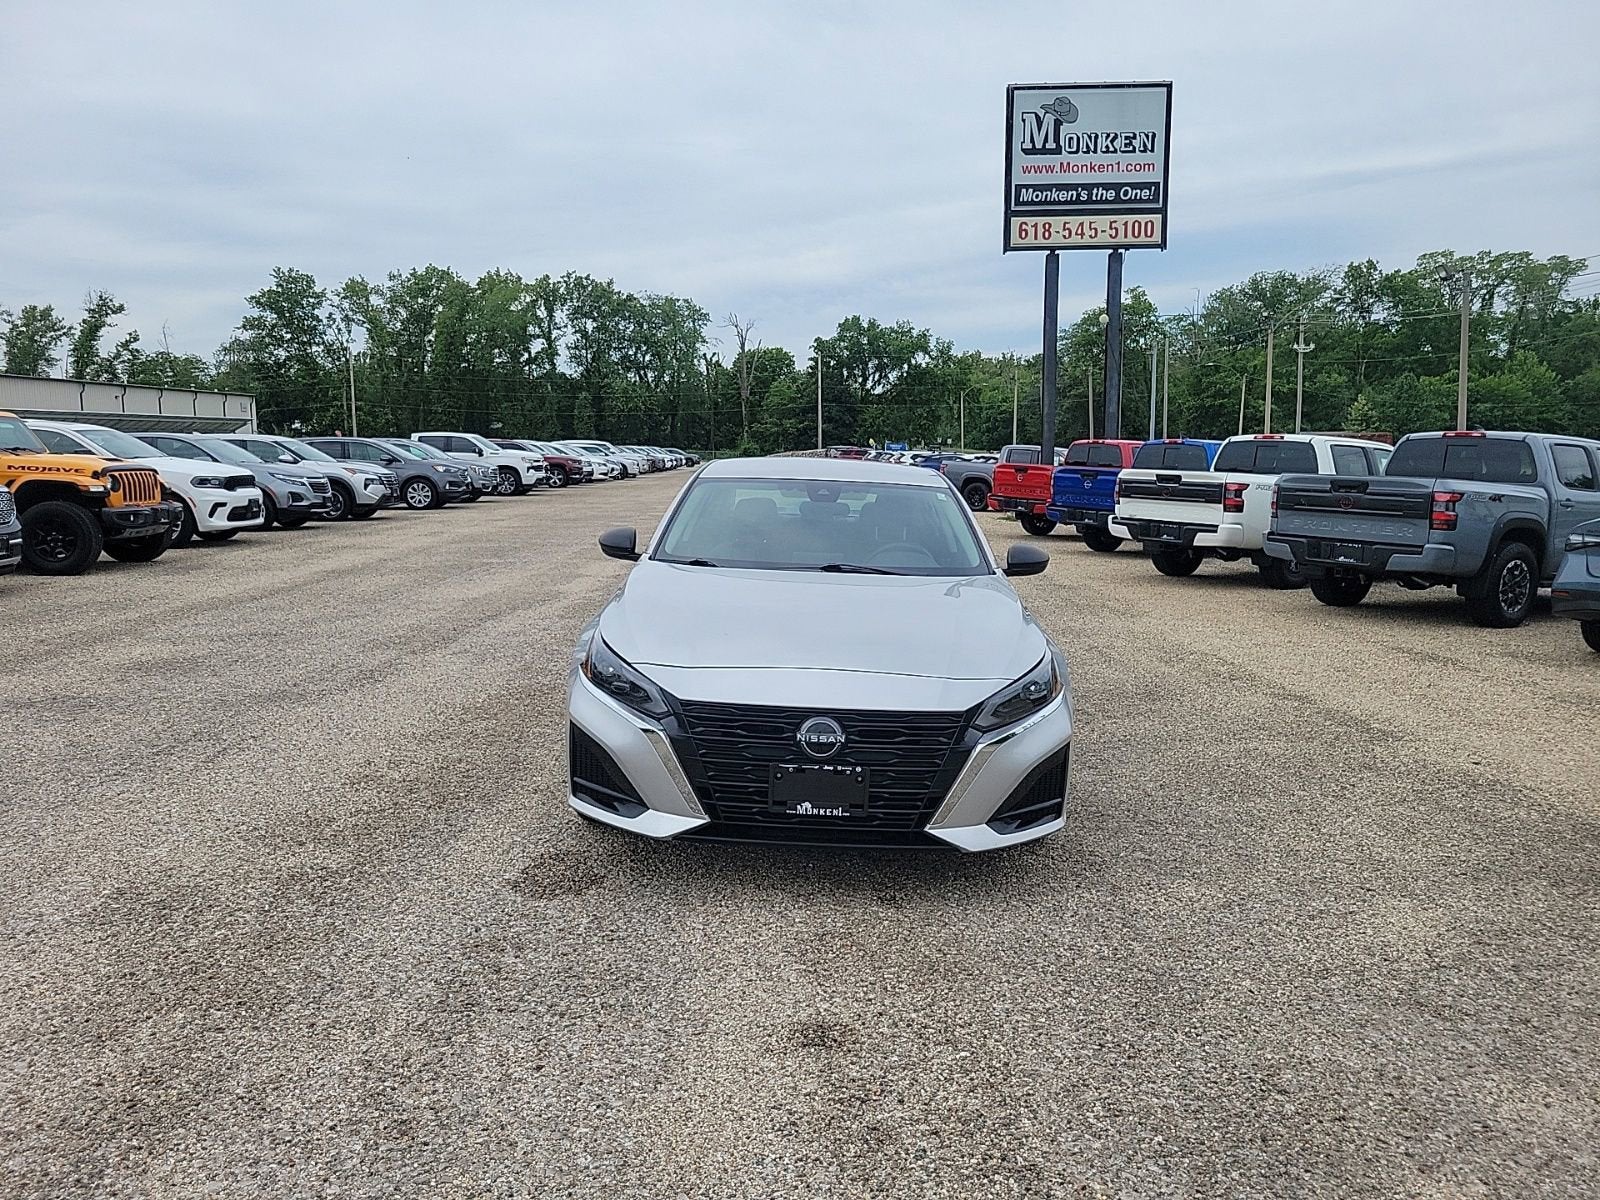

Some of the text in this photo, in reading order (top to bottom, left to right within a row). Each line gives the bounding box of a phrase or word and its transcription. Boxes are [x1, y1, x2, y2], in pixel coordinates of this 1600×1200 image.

[1021, 161, 1156, 174] www.Monken1.com
[1019, 186, 1156, 202] Monken's the One!
[1018, 219, 1155, 241] 618-545-5100
[7, 464, 87, 474] MOJAVE
[796, 733, 846, 743] NISSAN
